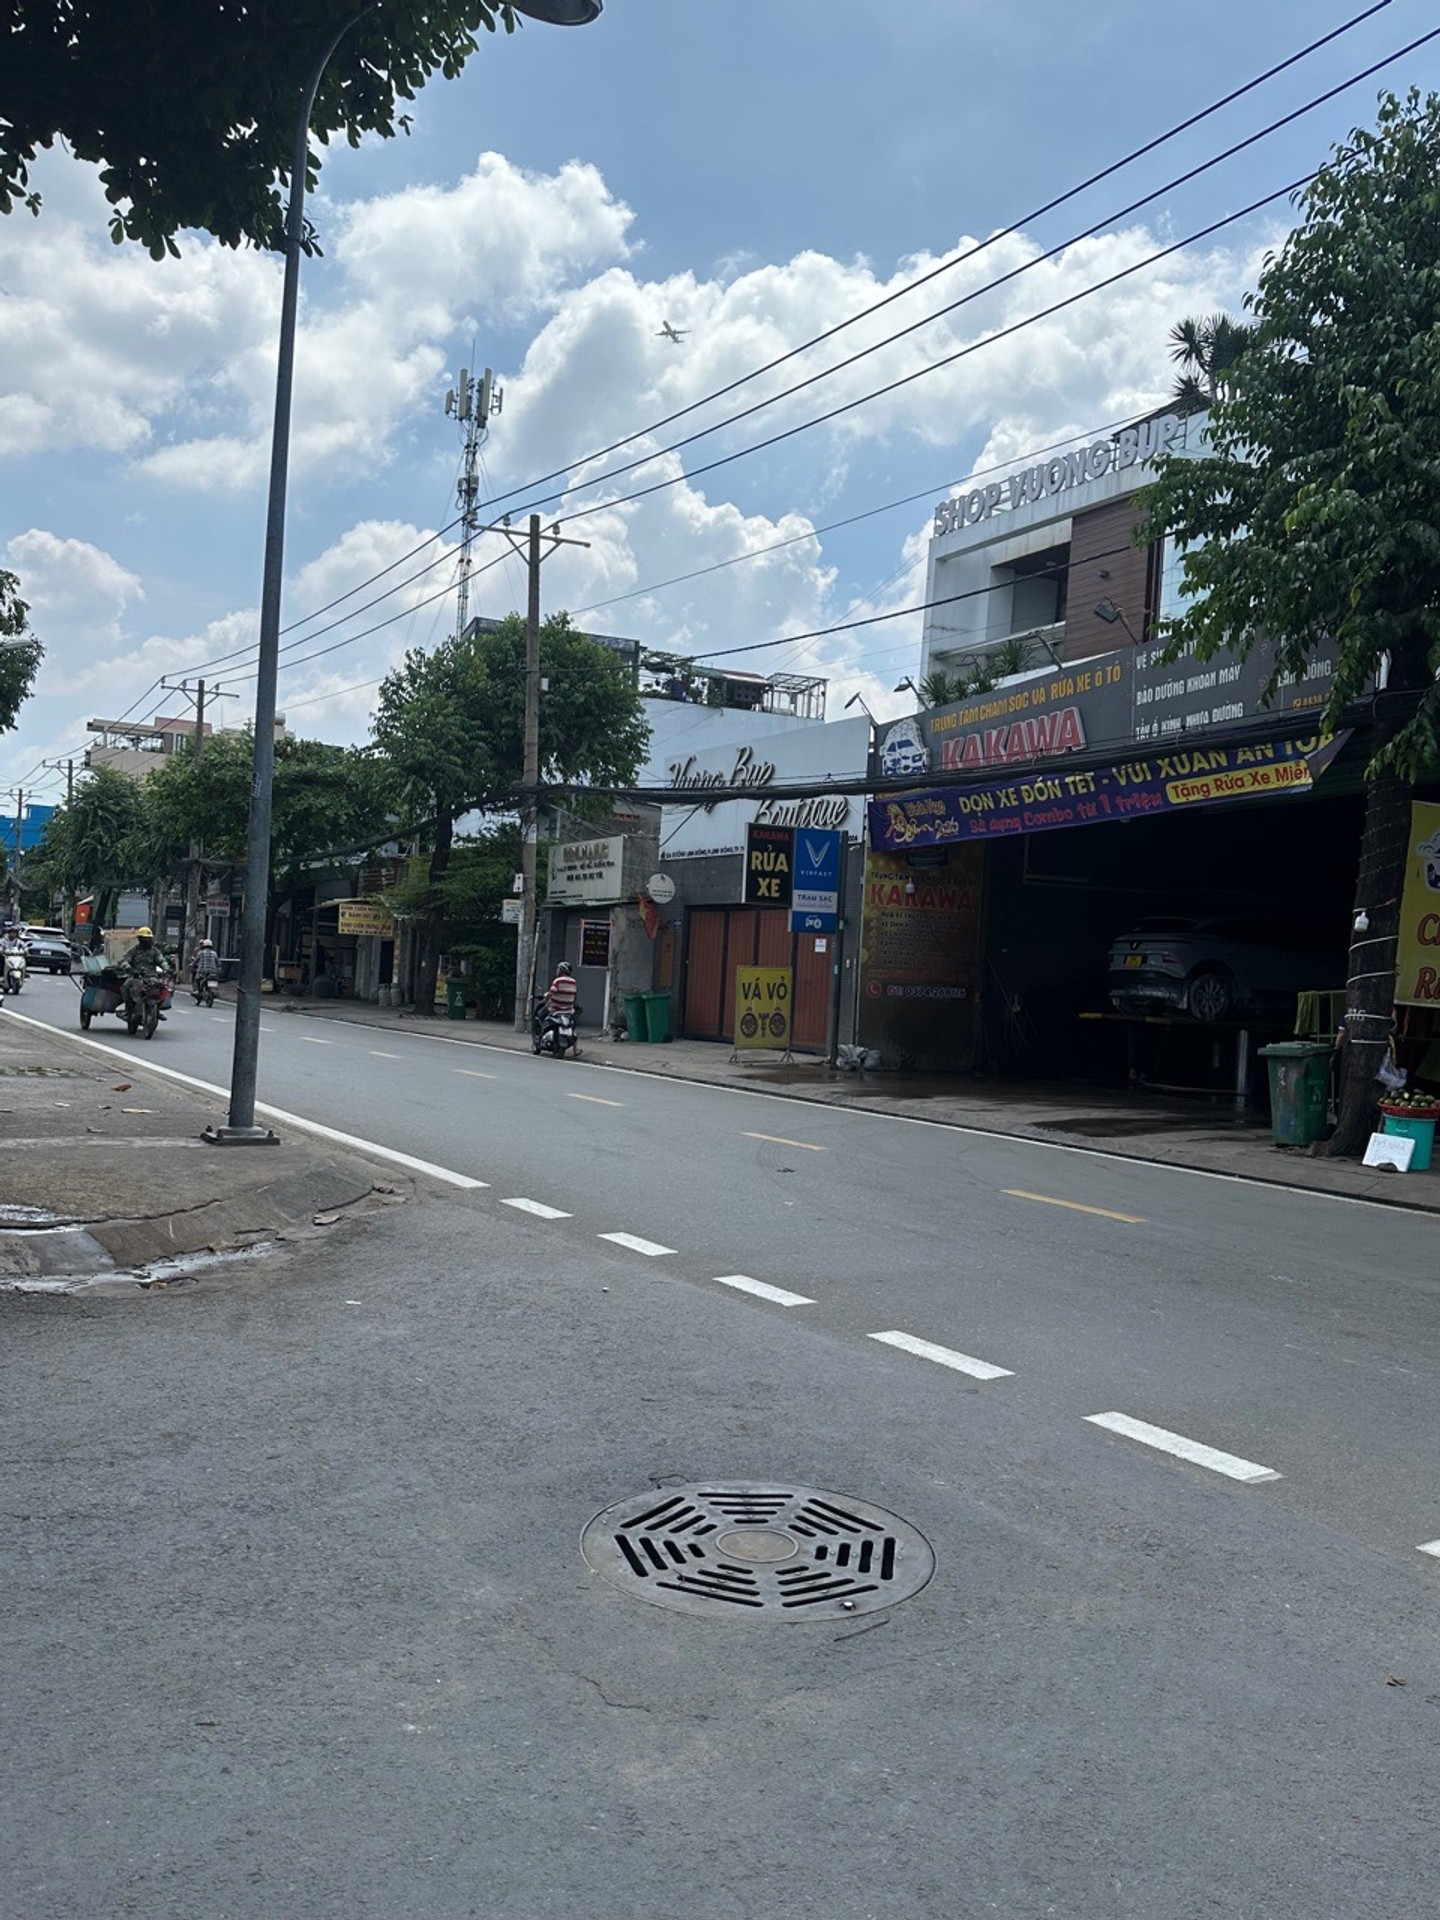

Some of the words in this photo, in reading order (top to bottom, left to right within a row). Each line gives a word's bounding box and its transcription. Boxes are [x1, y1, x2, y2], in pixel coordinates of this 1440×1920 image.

[933, 484, 1001, 537] SHOP
[1008, 440, 1113, 510] VUONG
[930, 712, 957, 733] TRUNG
[959, 704, 980, 727] TÂM
[1009, 686, 1029, 713] SÓC
[1032, 682, 1046, 706] VÀ
[1052, 672, 1074, 701] RỬA
[1077, 671, 1092, 693] XE
[1095, 665, 1103, 687] Ô
[1106, 660, 1122, 684] TÔ
[1136, 683, 1154, 706] BẢO
[1219, 662, 1241, 686] MÁY
[942, 706, 1086, 770] KAKAWA
[958, 790, 995, 816] DỌN
[996, 787, 1019, 809] XE
[1021, 776, 1062, 803] ĐÓN
[1171, 782, 1211, 802] Tặng
[1213, 772, 1246, 792] Rửa
[1250, 769, 1271, 786] Xe
[1024, 808, 1074, 827] Combo
[1099, 794, 1112, 813] 1
[751, 844, 789, 873] RỬA
[757, 877, 781, 898] XE
[741, 976, 762, 1000] VÁ
[766, 975, 788, 1000] VỎ
